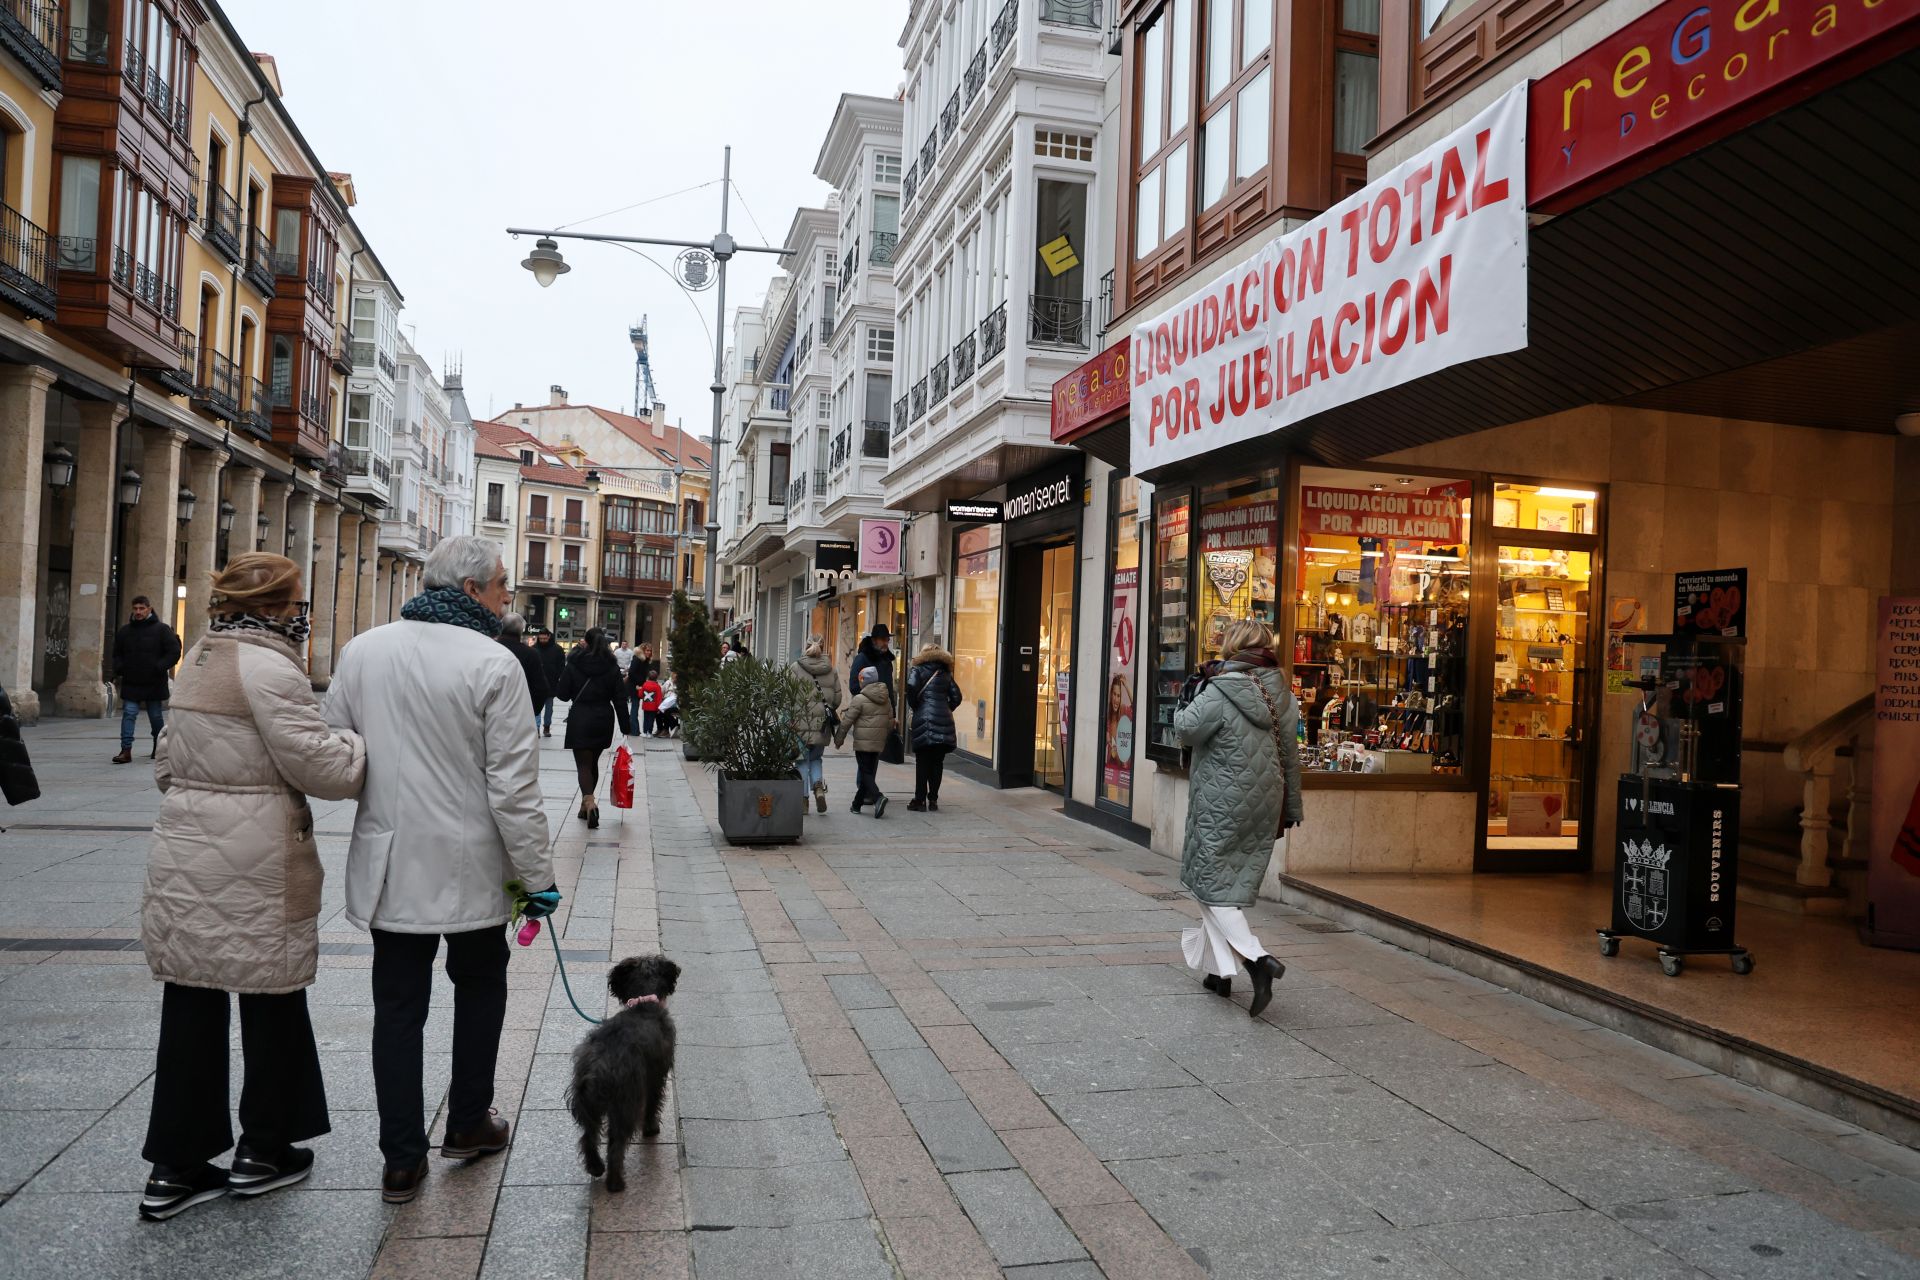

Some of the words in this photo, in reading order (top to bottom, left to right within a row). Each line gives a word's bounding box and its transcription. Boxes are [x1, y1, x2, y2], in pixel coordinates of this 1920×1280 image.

[1619, 0, 1884, 138] Decora
[1134, 226, 1328, 388] LIQUIDACION
[1340, 127, 1510, 279] TOTAL
[1148, 377, 1202, 447] POR
[1209, 253, 1453, 426] JUBILACION
[1003, 474, 1070, 520] women'secret
[1306, 490, 1408, 515] LIQUIDACIÓN
[1412, 498, 1460, 519] TOTAL
[949, 505, 998, 515] women'secret
[1248, 504, 1276, 523] TOTAL
[1206, 533, 1221, 549] POR
[1222, 525, 1269, 548] JUBILACIÓN
[1320, 513, 1353, 532] POR
[1357, 516, 1450, 539] JUBILACIÓN
[1679, 576, 1706, 584] Convierte
[1715, 573, 1738, 582] moneda
[1892, 605, 1920, 616] REGA
[1893, 645, 1920, 657] CERA
[1640, 799, 1675, 815] PLENCIA
[1710, 809, 1722, 902] SOUVENIRS
